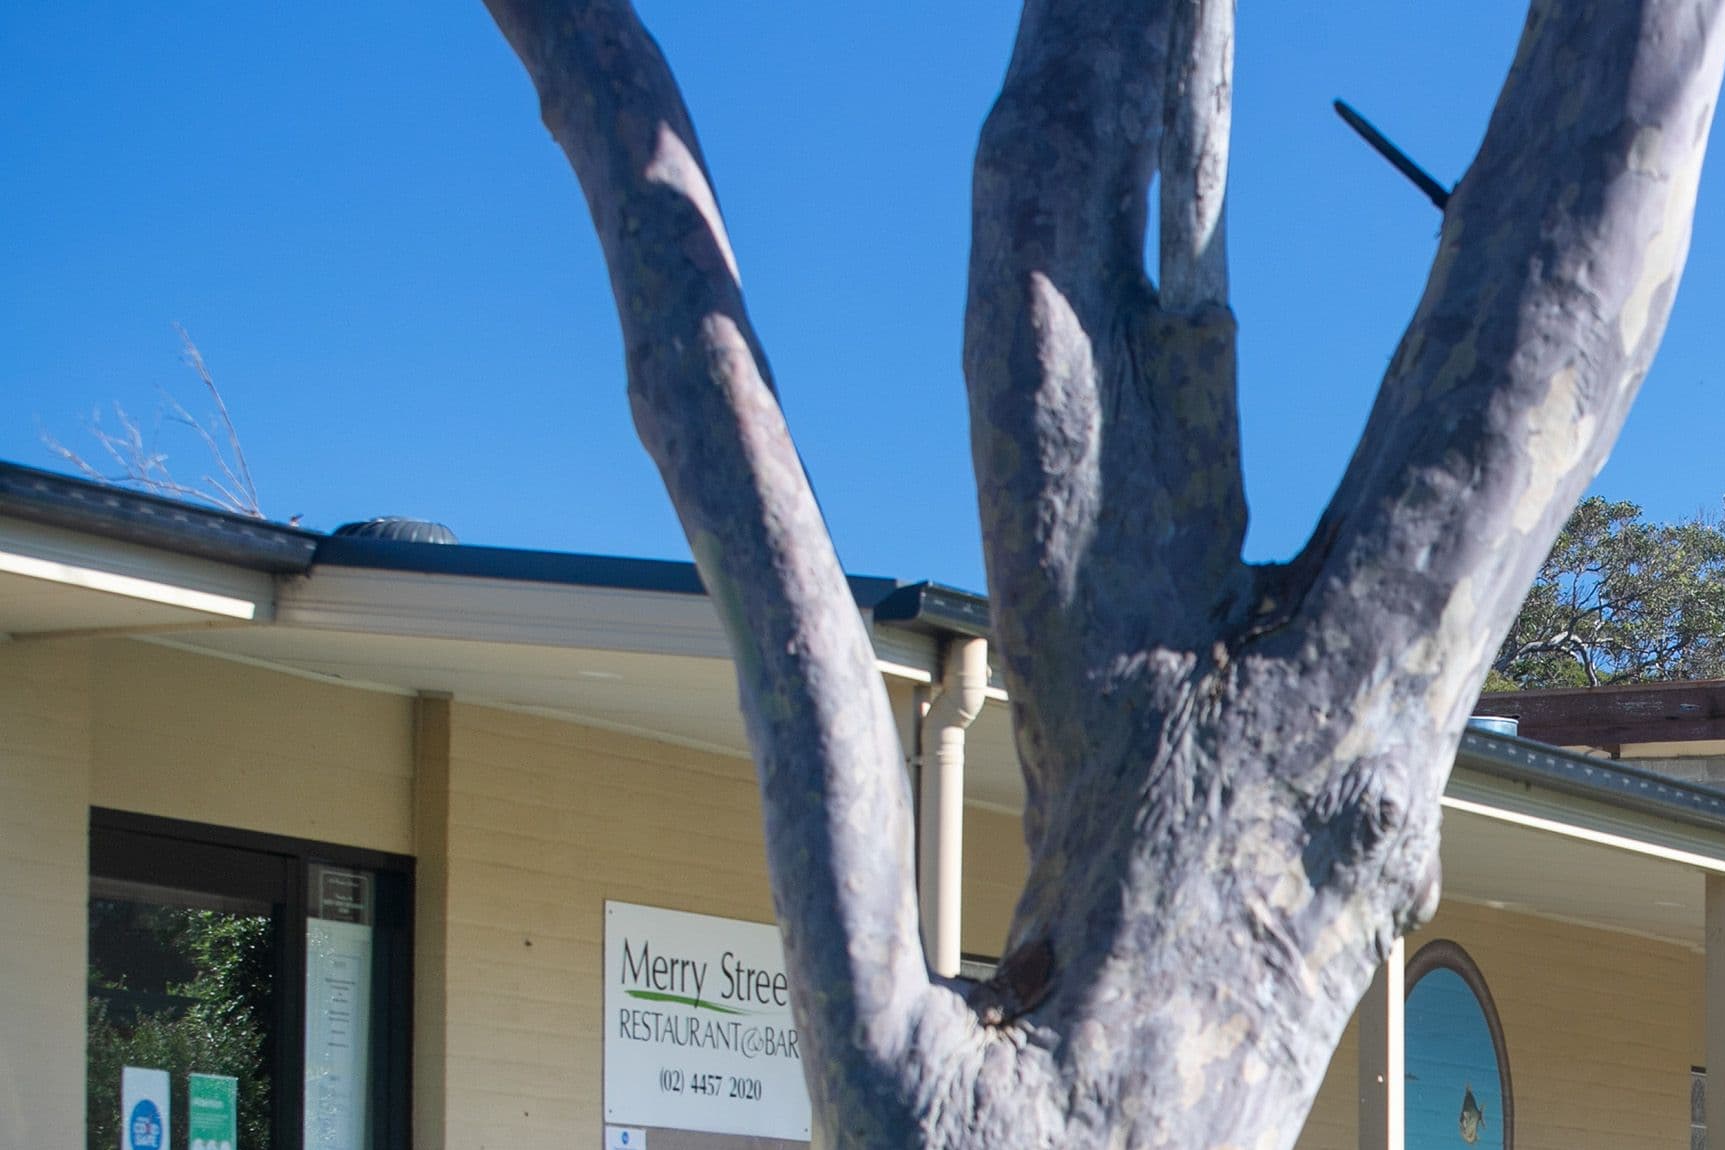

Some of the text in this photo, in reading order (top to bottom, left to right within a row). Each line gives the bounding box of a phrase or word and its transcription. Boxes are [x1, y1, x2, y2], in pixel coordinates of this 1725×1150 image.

[621, 937, 788, 1008] Merry Stree
[659, 1066, 762, 1101] (02) 4457 2020
